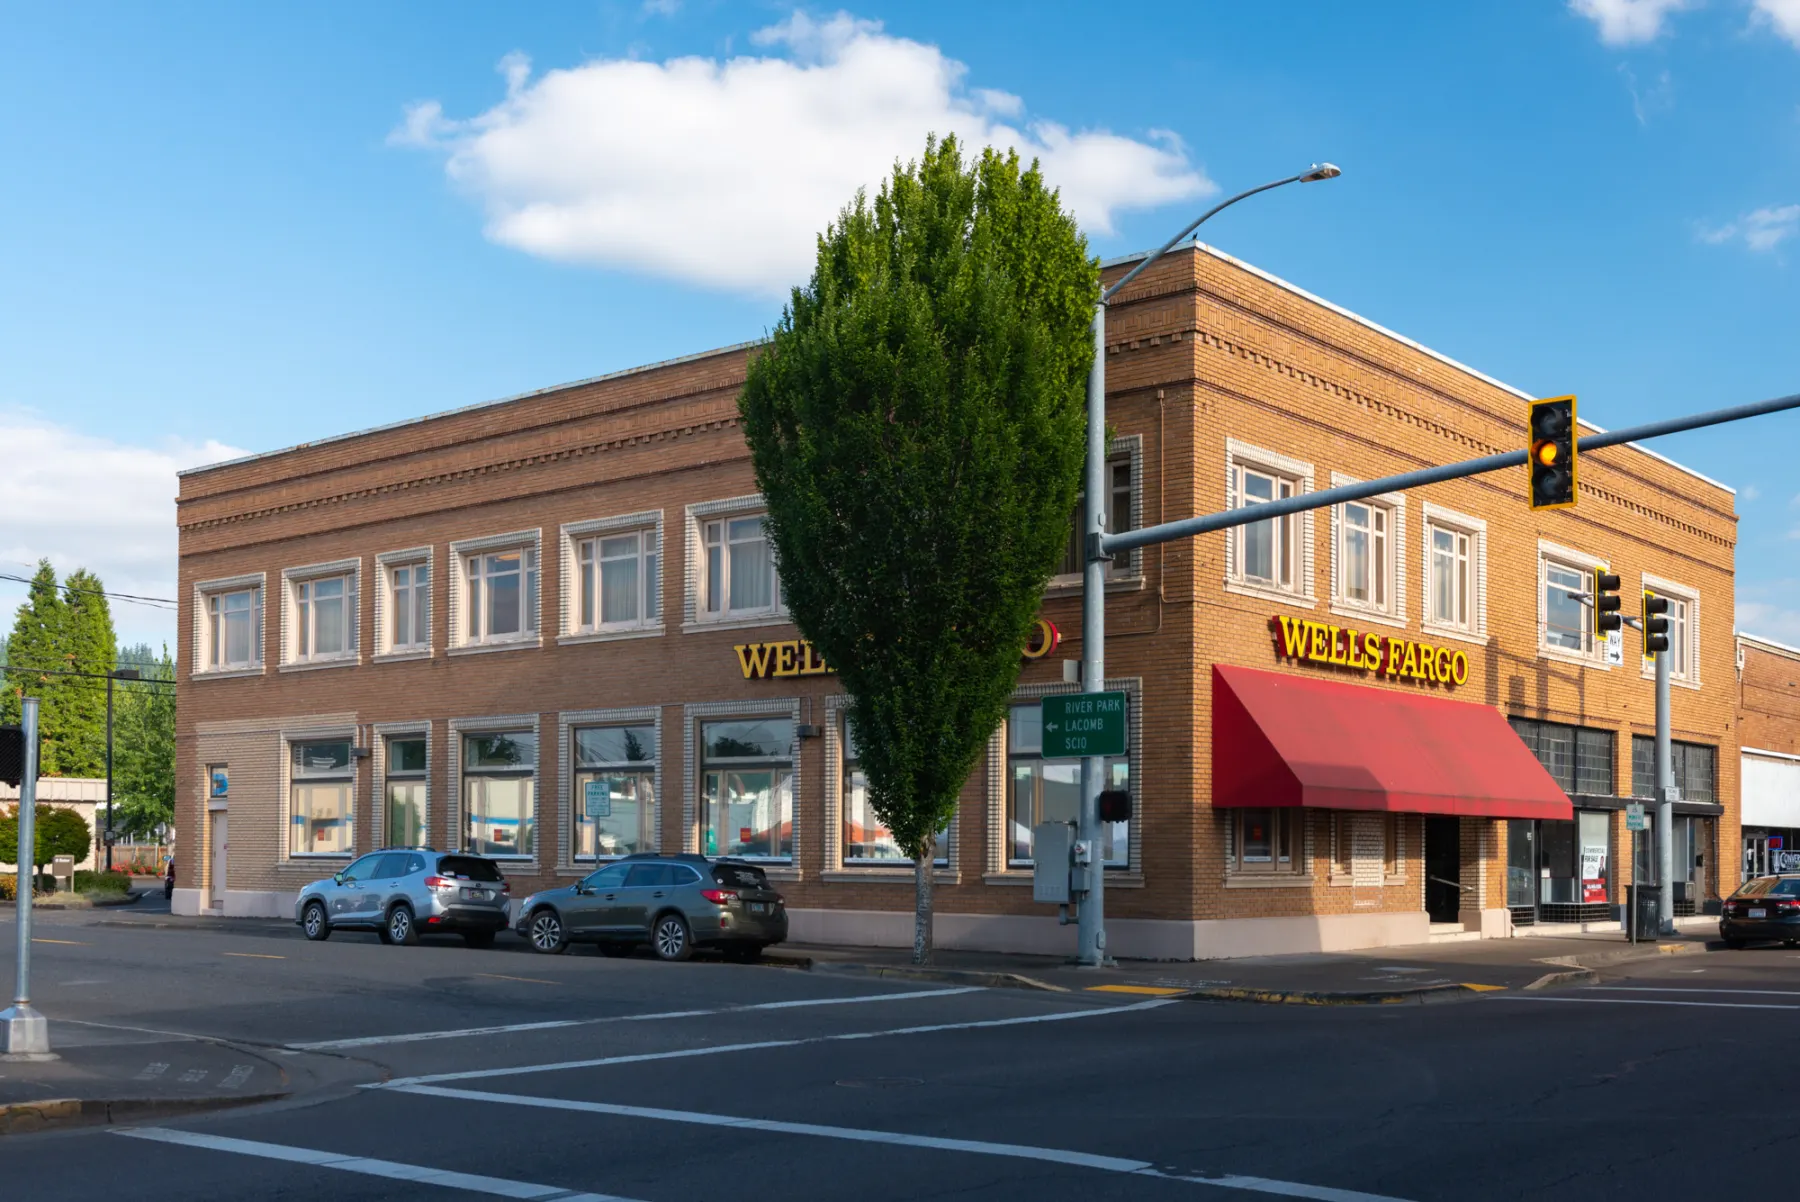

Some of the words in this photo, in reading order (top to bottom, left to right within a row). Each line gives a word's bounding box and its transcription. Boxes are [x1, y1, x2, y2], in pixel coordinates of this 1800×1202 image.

[1609, 635, 1620, 647] WAY
[1277, 615, 1381, 671] WELLS
[1385, 637, 1469, 686] FARGO
[734, 639, 838, 679] WEL
[1065, 701, 1093, 714] RIVER
[1096, 699, 1120, 712] PARK
[1065, 718, 1104, 732] LACOMB
[1065, 737, 1087, 750] SCIO
[1591, 855, 1599, 863] SALE
